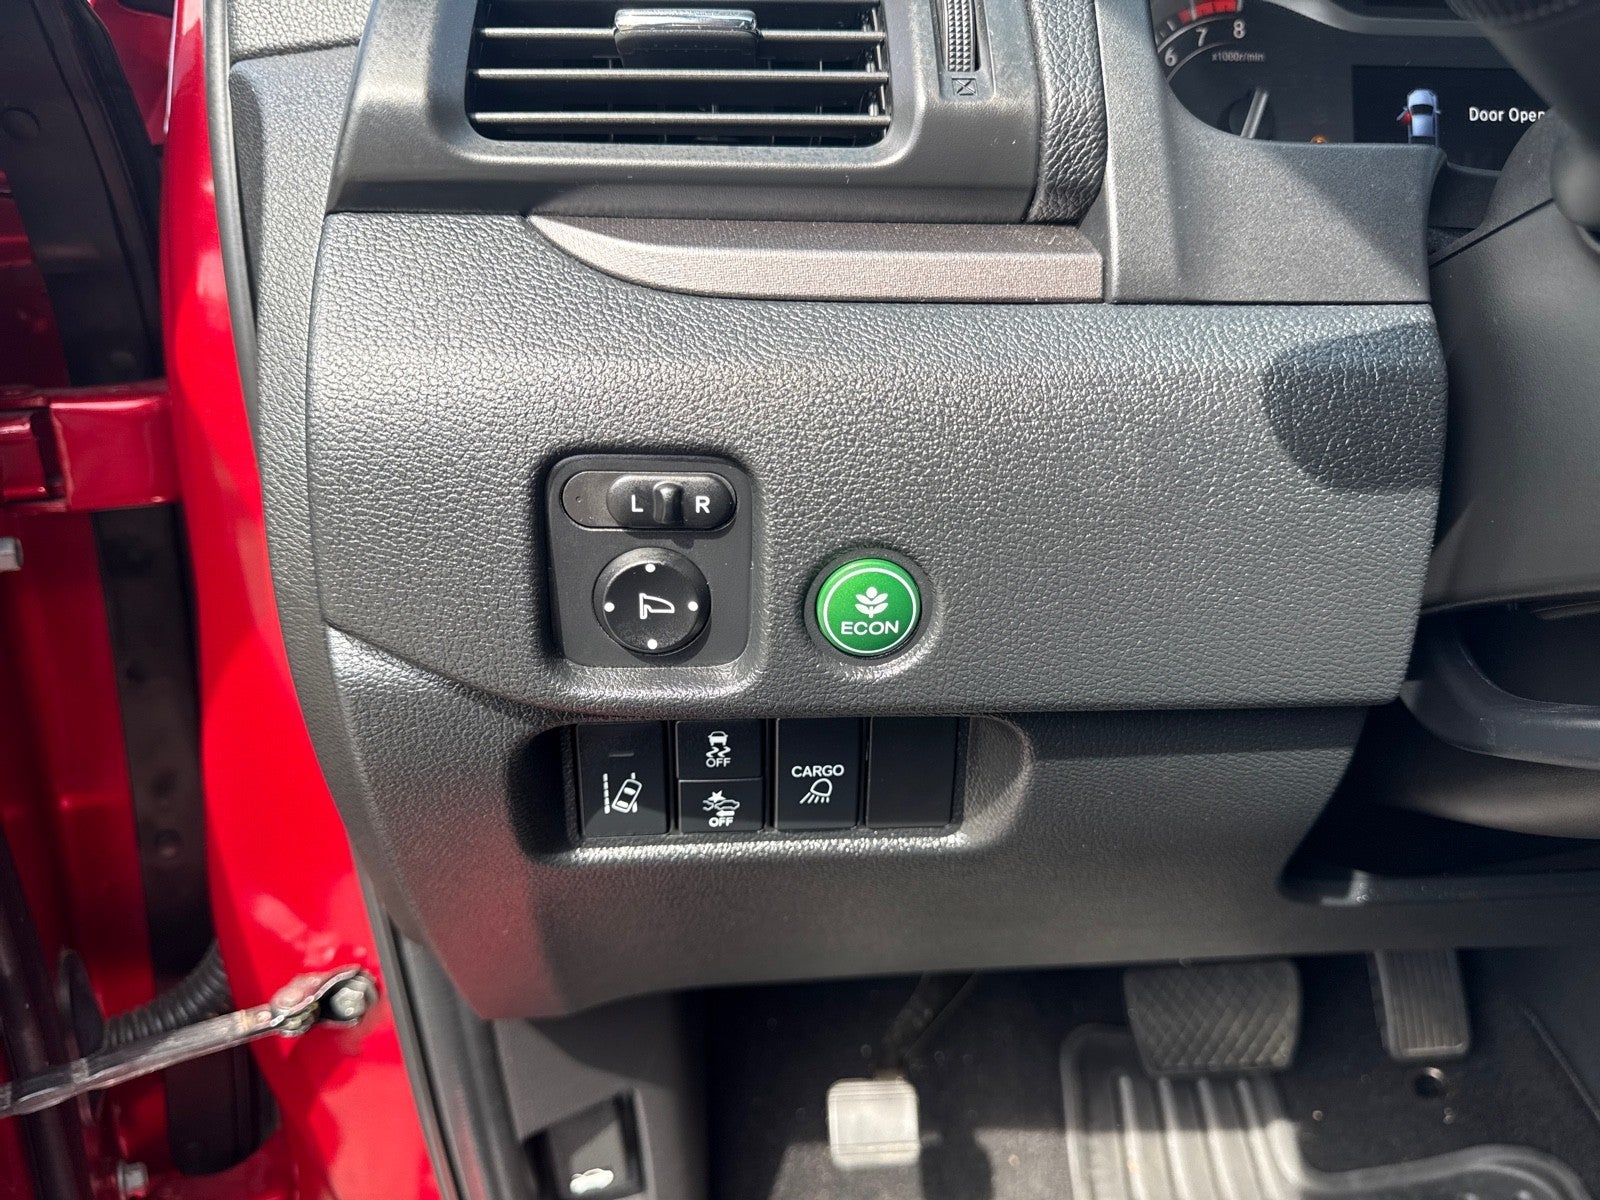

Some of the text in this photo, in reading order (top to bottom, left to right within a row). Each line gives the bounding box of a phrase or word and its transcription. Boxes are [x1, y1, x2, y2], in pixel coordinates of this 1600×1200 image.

[1195, 28, 1208, 47] 7
[1232, 20, 1247, 39] 8
[1164, 48, 1178, 67] 6
[1469, 106, 1505, 122] Door
[631, 494, 711, 514] L R
[840, 619, 899, 636] ECON
[705, 757, 731, 768] OFF
[791, 764, 845, 778] CARGO
[708, 817, 734, 828] OFF
